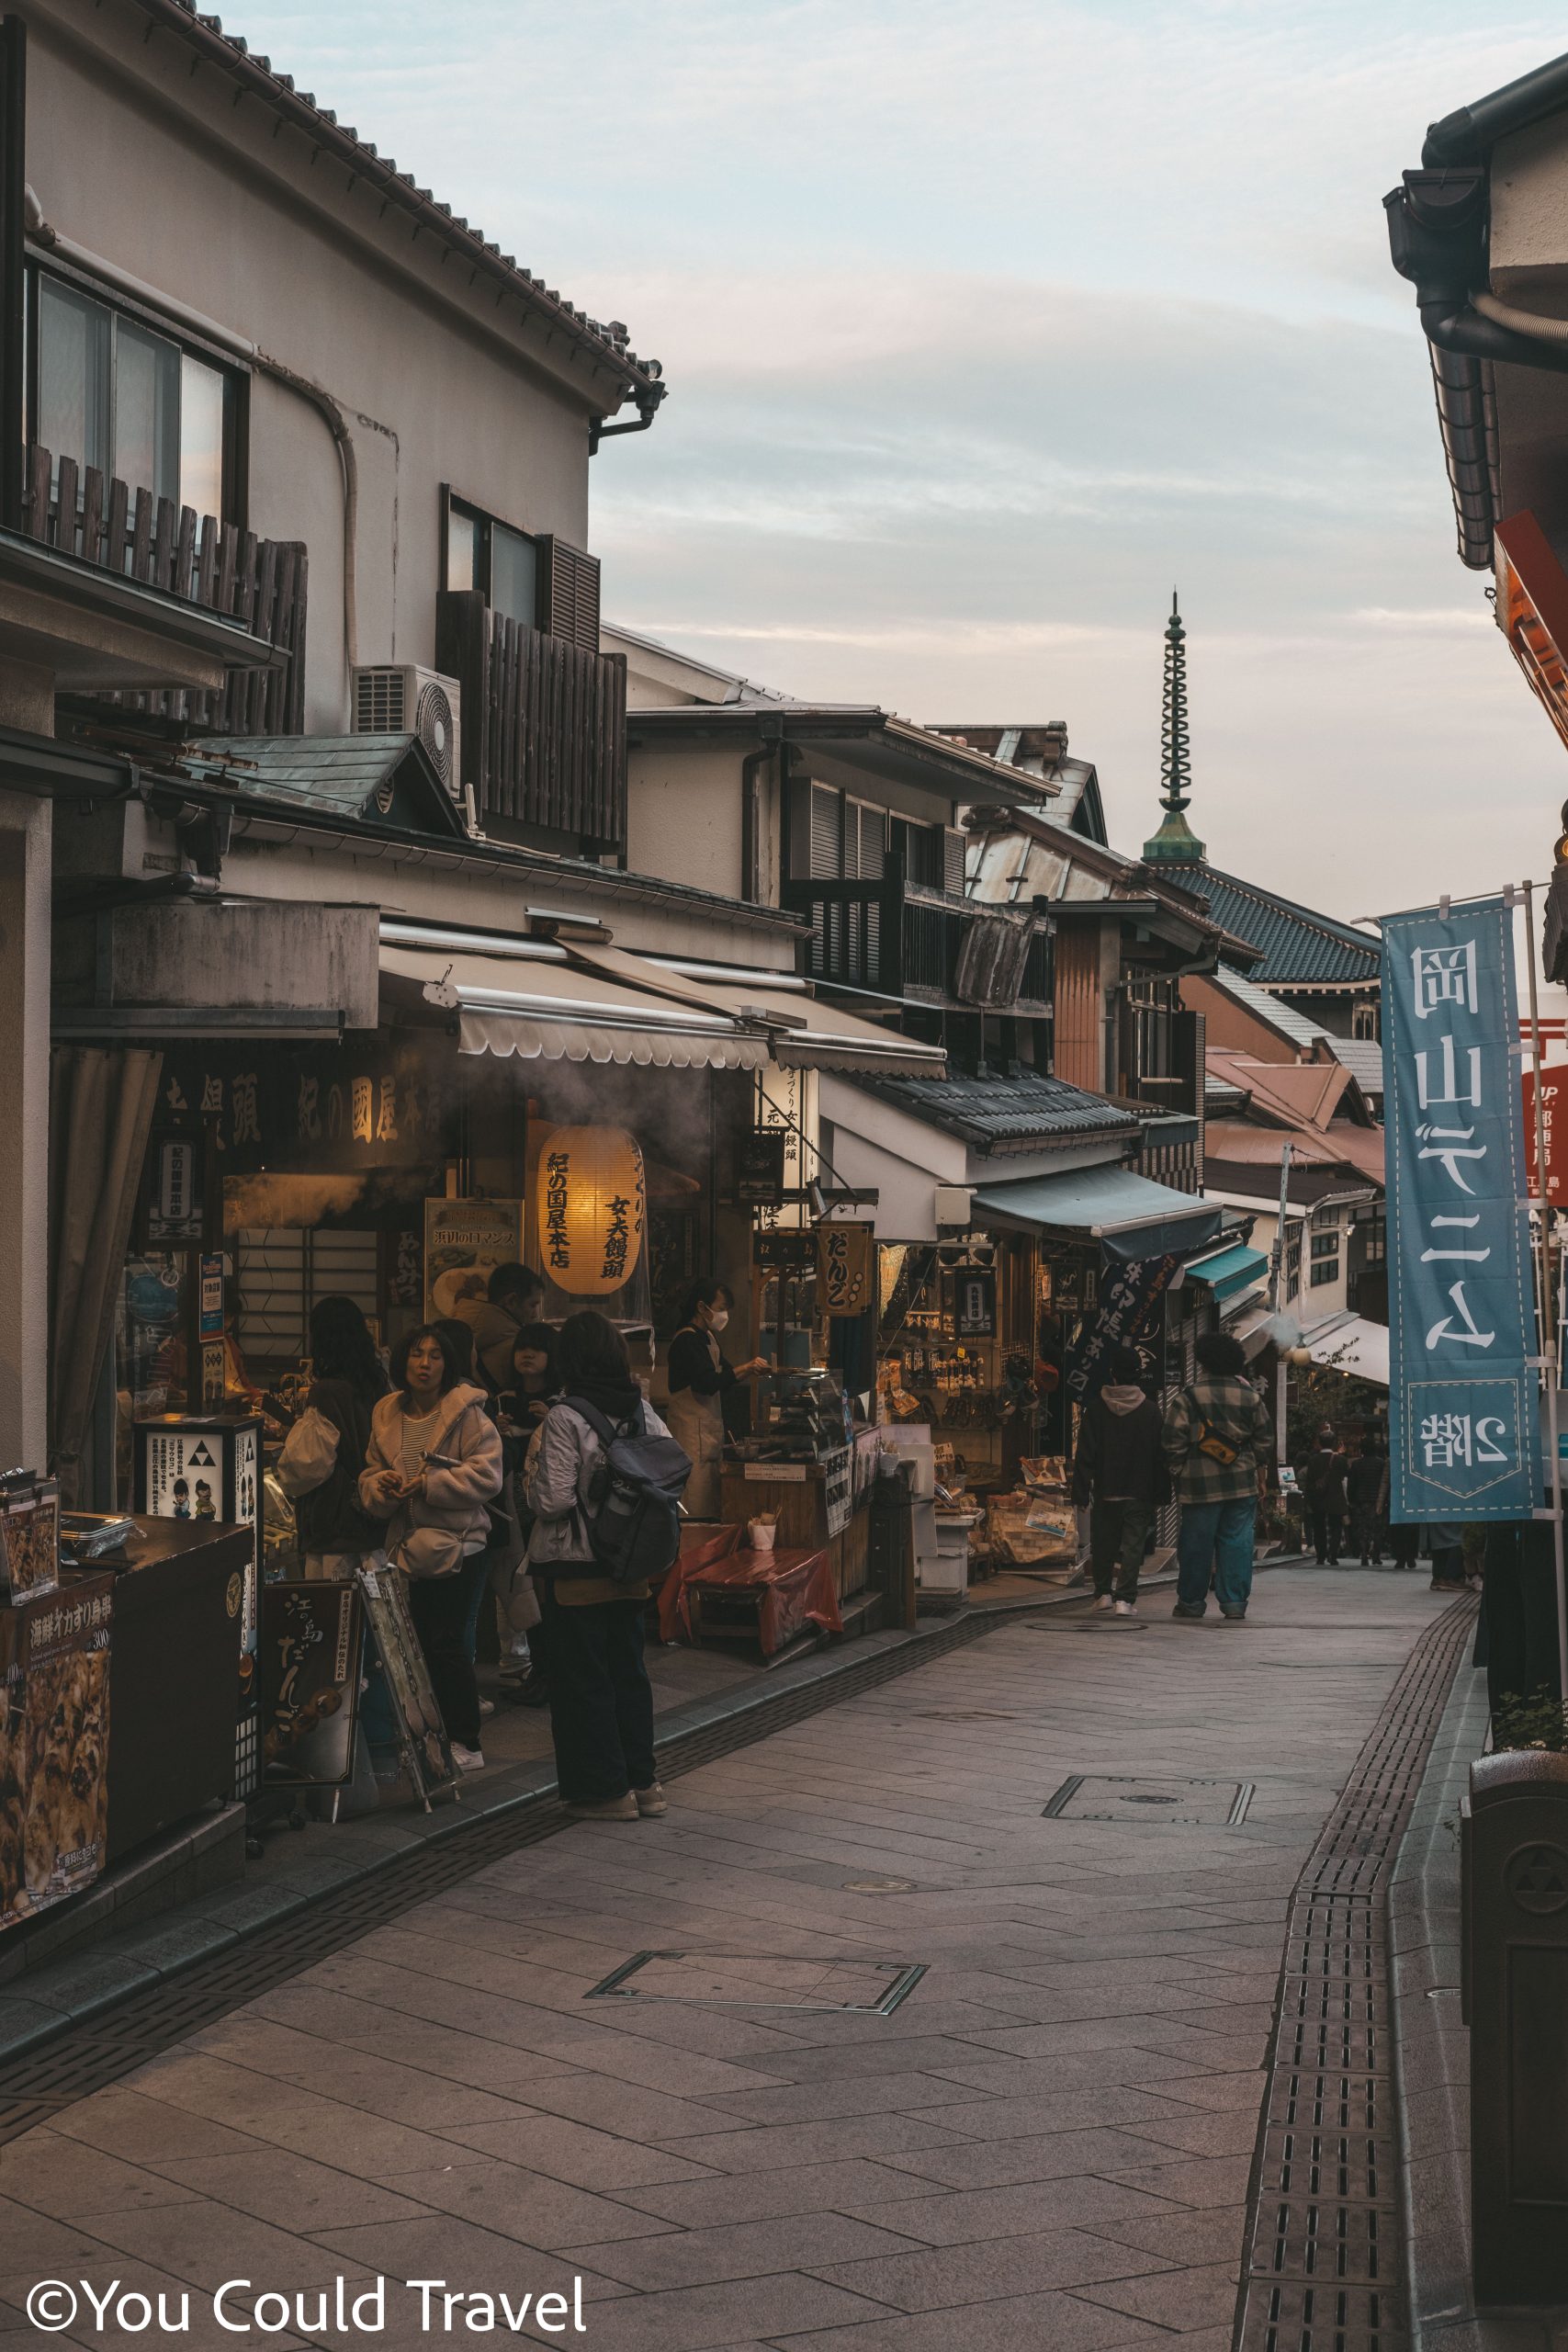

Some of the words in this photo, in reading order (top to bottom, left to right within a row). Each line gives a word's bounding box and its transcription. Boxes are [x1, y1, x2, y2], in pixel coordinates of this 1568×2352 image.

[547, 1152, 570, 1269] 紀の国屋本店
[1527, 1176, 1560, 1188] 江島
[827, 1232, 848, 1306] だんご
[30, 1593, 112, 1649] 海鮮イカすり身串
